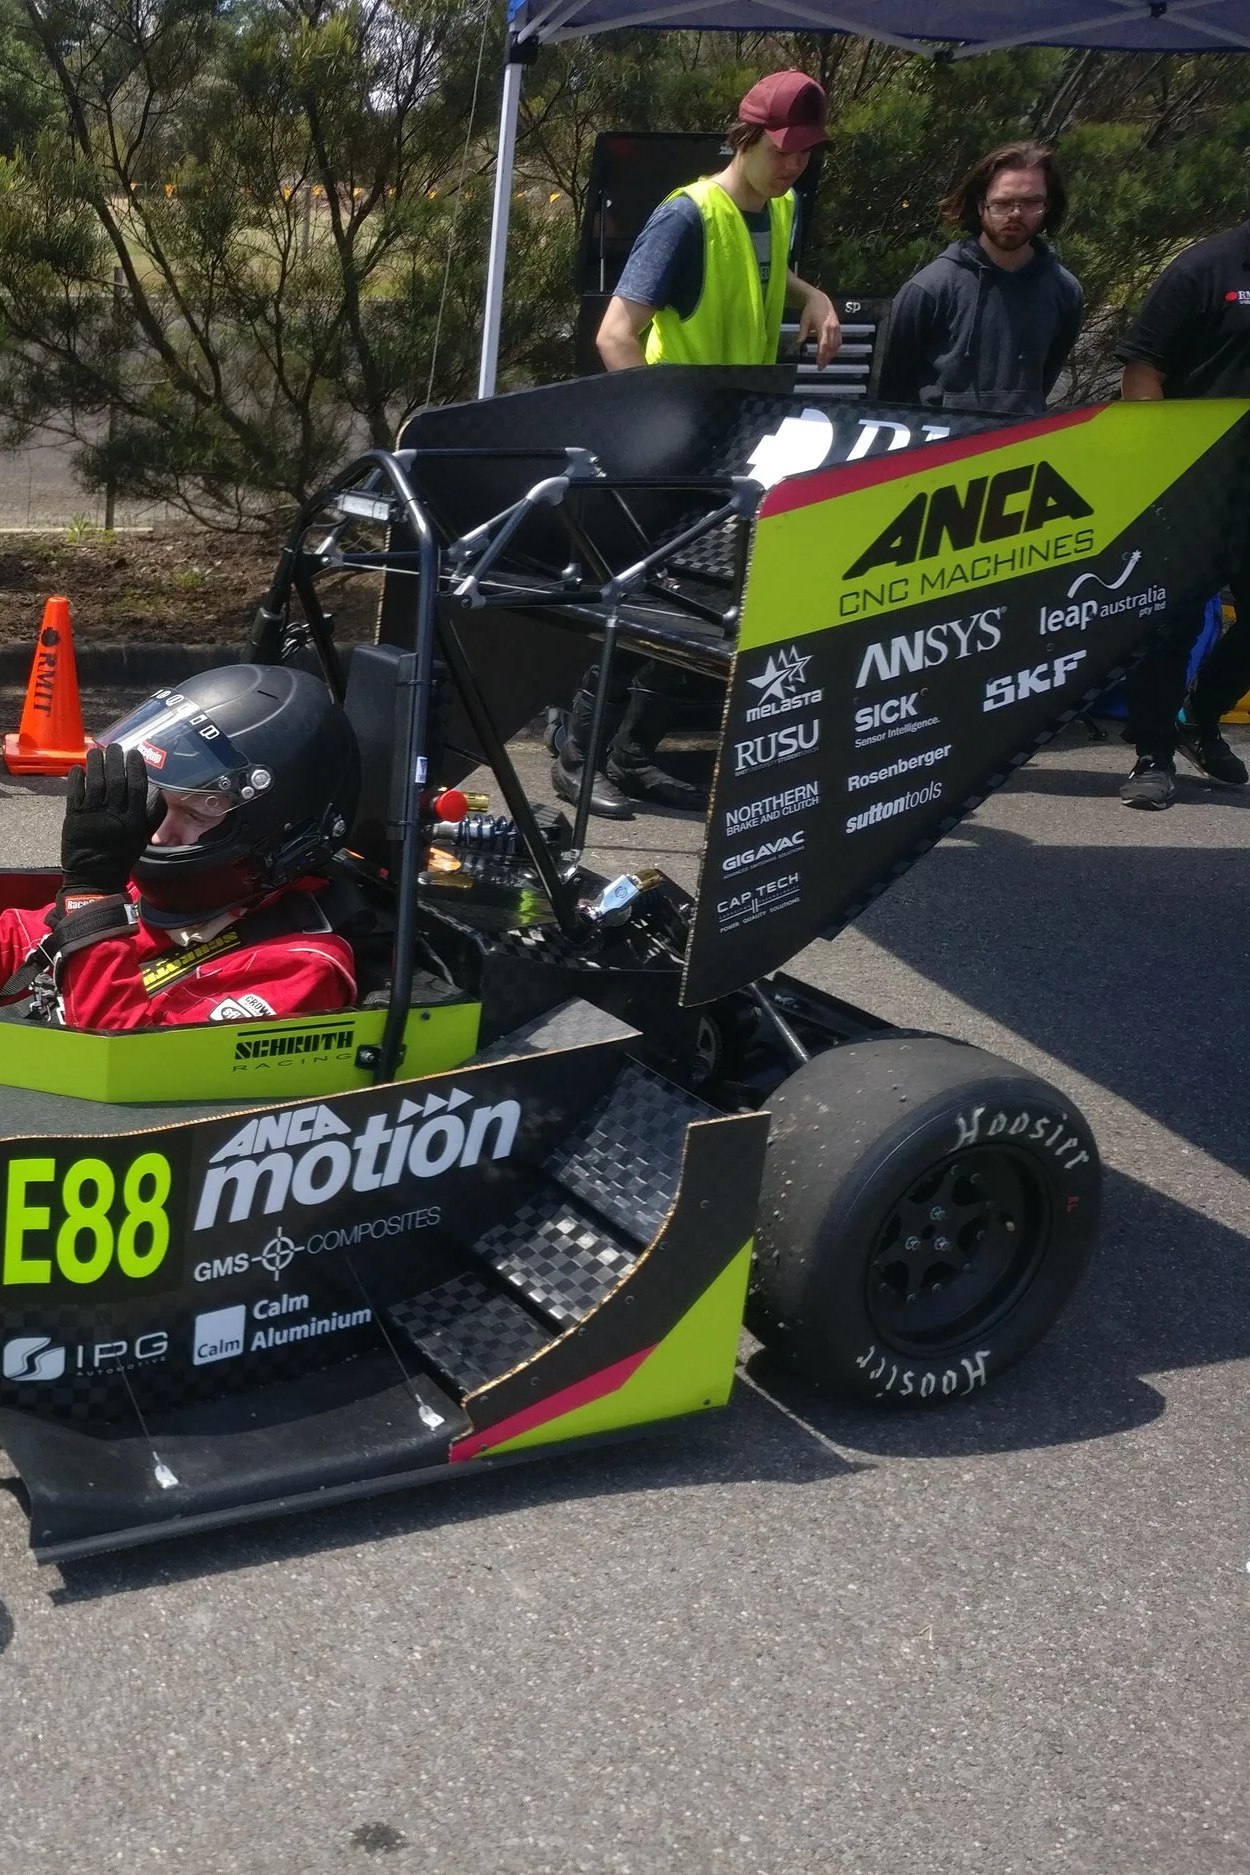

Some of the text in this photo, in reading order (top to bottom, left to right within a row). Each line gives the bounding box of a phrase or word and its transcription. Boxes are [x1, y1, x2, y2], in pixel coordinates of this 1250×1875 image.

[842, 460, 1094, 581] ANCA
[840, 528, 1095, 617] CNC MACHINES
[1039, 585, 1166, 635] leap australia
[855, 607, 1003, 689] ANSYS
[34, 653, 56, 718] RMIT
[983, 650, 1087, 712] SKF
[854, 692, 919, 732] SICK
[734, 719, 819, 771] RUSU
[854, 731, 886, 748] Sensor
[847, 744, 952, 792] Rosenberger
[726, 781, 818, 827] NORTHERN
[726, 796, 819, 836] BRAKE AND CLUTCH
[846, 781, 943, 834] suttontools
[722, 830, 804, 871] GIGAVAC
[717, 892, 752, 913] CAP
[756, 872, 798, 896] TECH
[232, 1053, 352, 1072] RACING
[235, 1030, 355, 1060] SCHROTH
[209, 1104, 351, 1163] ANCA
[949, 1105, 1090, 1169] Hoosier
[193, 1099, 521, 1231] motion
[3, 1152, 172, 1286] E88
[193, 1206, 442, 1282] GMS COMPOSITES
[250, 1307, 372, 1351] Aluminium
[252, 1292, 310, 1321] Calm
[77, 1331, 168, 1368] IPG
[197, 1338, 241, 1359] Calm
[855, 1345, 991, 1398] Hoosier
